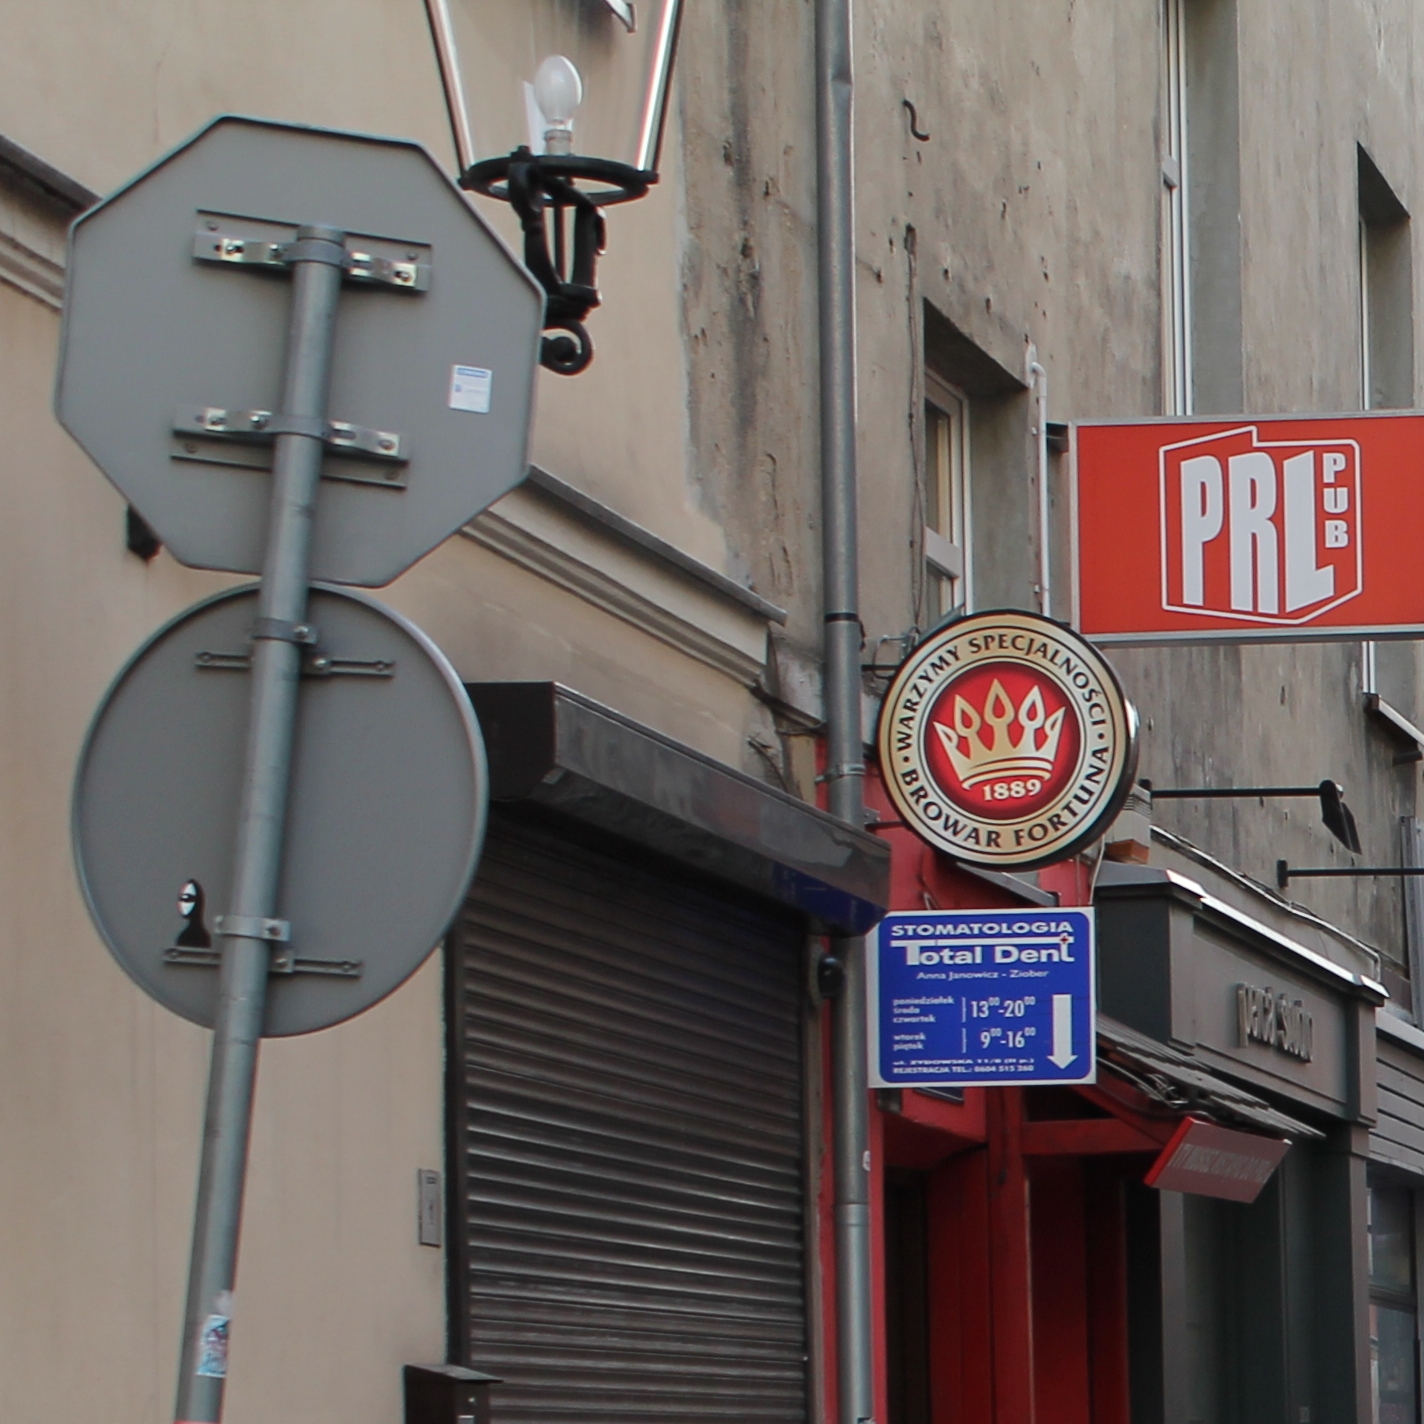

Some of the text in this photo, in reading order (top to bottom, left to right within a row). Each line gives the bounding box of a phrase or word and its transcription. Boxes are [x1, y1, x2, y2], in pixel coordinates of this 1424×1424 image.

[1322, 452, 1349, 549] PUB
[1179, 449, 1336, 614] PRL
[896, 633, 1107, 752] WARZYMY SPECJALNOŚCI
[901, 745, 1111, 848] BROWAR FORTUNA
[982, 778, 1042, 801] 1889
[890, 921, 1074, 937] STOMATOLOGIA
[905, 936, 1076, 966] Total Dent
[916, 971, 947, 980] Anna
[947, 970, 999, 982] Janowicz
[1009, 969, 1050, 979] Ziober
[893, 1031, 927, 1041] wtorek
[893, 1066, 950, 1074] REJESTRACJA
